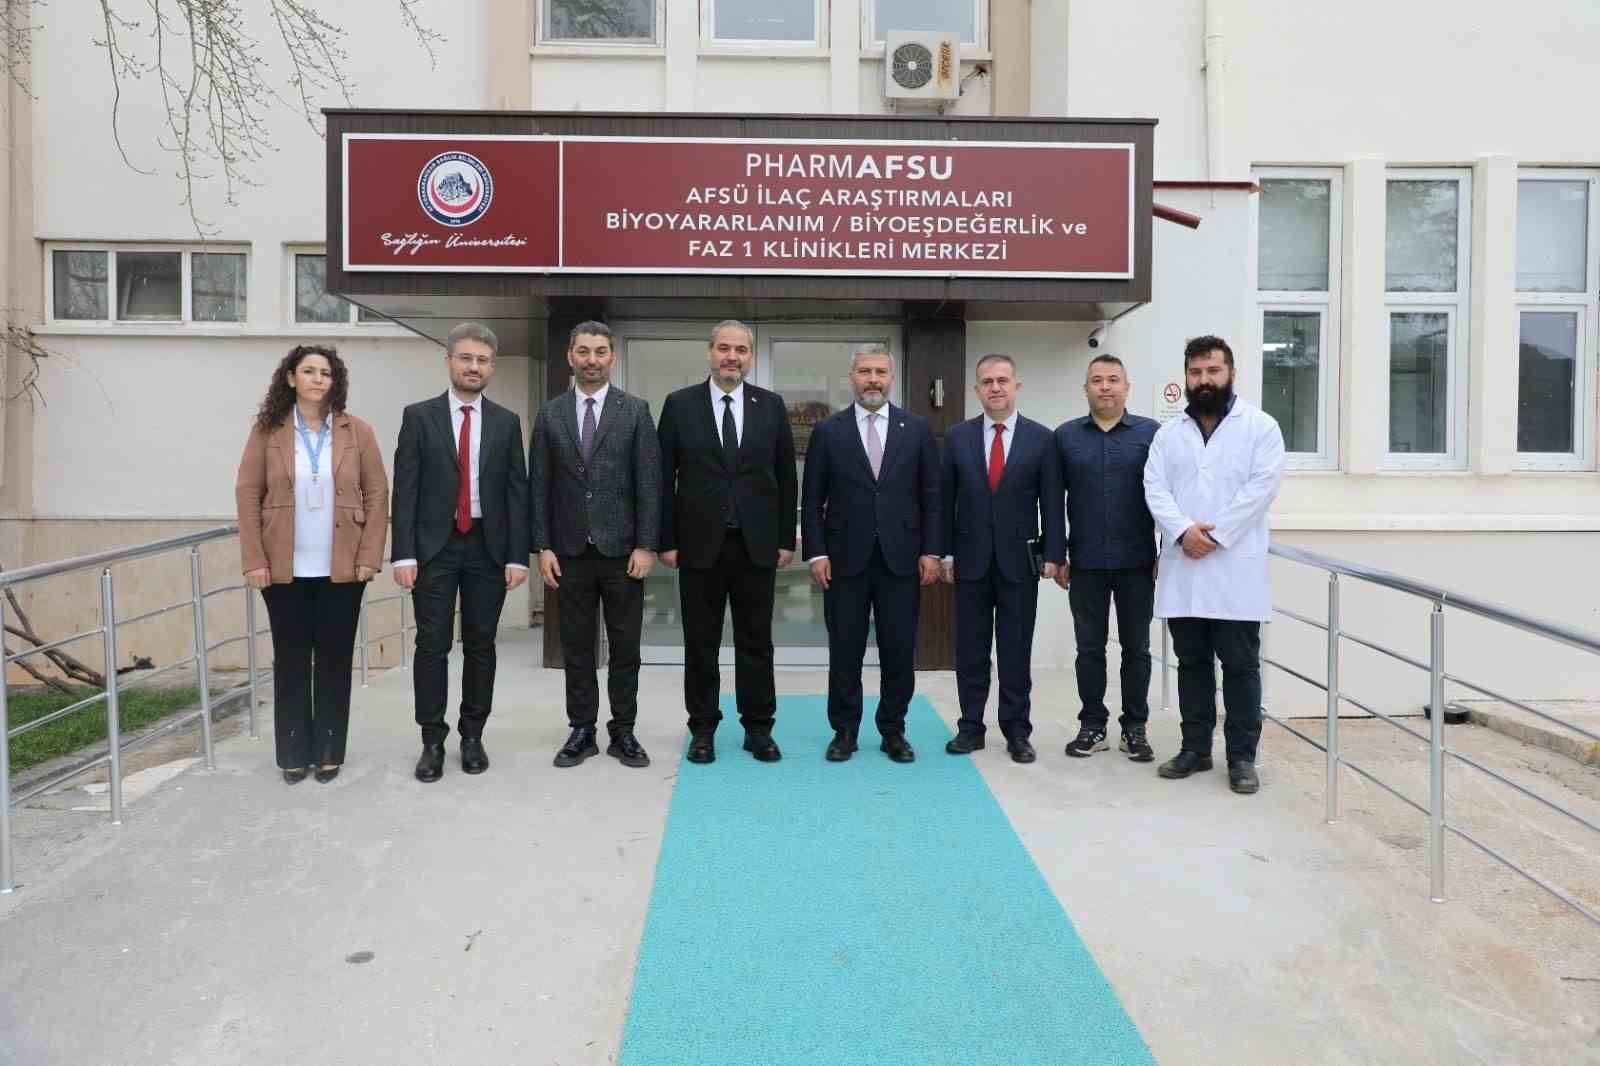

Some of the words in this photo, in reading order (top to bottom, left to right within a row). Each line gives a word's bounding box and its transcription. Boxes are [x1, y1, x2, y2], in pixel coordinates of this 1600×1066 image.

[746, 153, 953, 180] PHARMAFSU
[686, 184, 748, 205] AFSÜ
[757, 184, 811, 210] İLAÇ
[819, 189, 1013, 211] ARAŞTIRMALARI
[606, 209, 825, 232] BİYOYARARLANIM
[832, 215, 842, 232] /
[850, 212, 1054, 238] BİYOEŞDEĞERLİK
[1062, 222, 1088, 235] ve
[381, 232, 441, 255] Sağlığın
[445, 233, 528, 248] Üniversitesi
[688, 240, 734, 257] FAZ
[743, 241, 753, 257] 1
[763, 238, 895, 259] KLİNİKLERİ
[902, 239, 1007, 260] MERKEZİ
